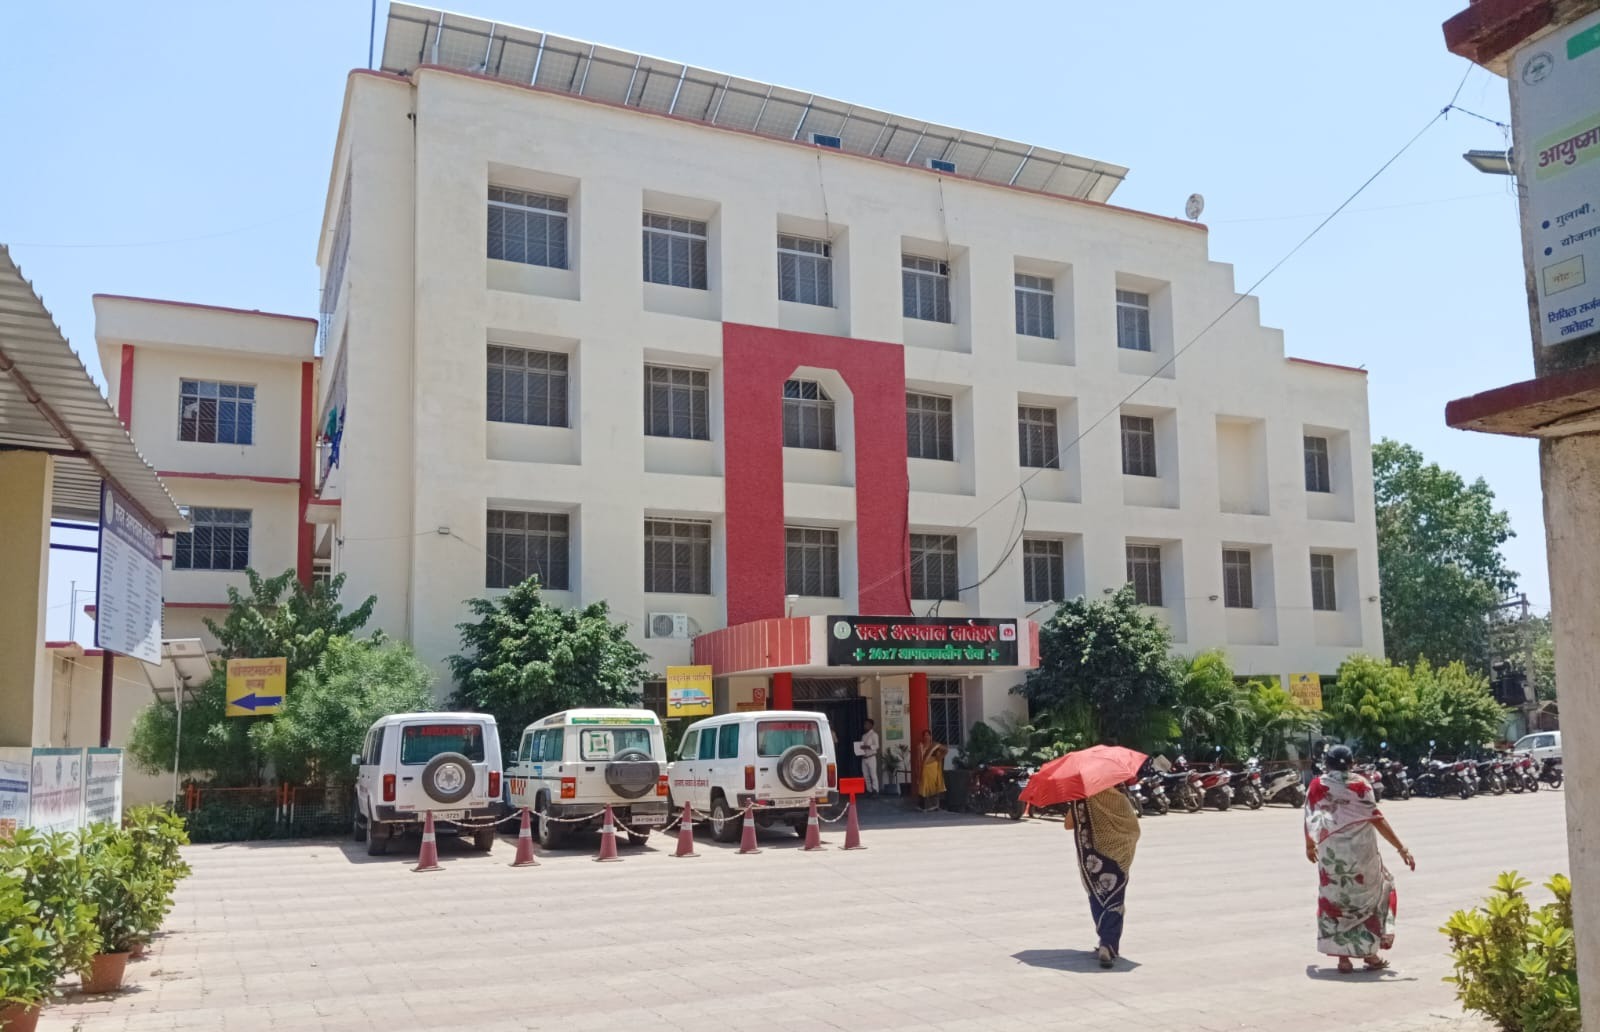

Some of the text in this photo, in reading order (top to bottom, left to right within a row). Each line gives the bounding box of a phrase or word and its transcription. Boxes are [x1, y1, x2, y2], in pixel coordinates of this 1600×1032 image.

[1538, 126, 1600, 167] आयुष्म
[1560, 317, 1594, 336] लातेहार
[854, 619, 997, 643] सदर अस्पताल लातेहार
